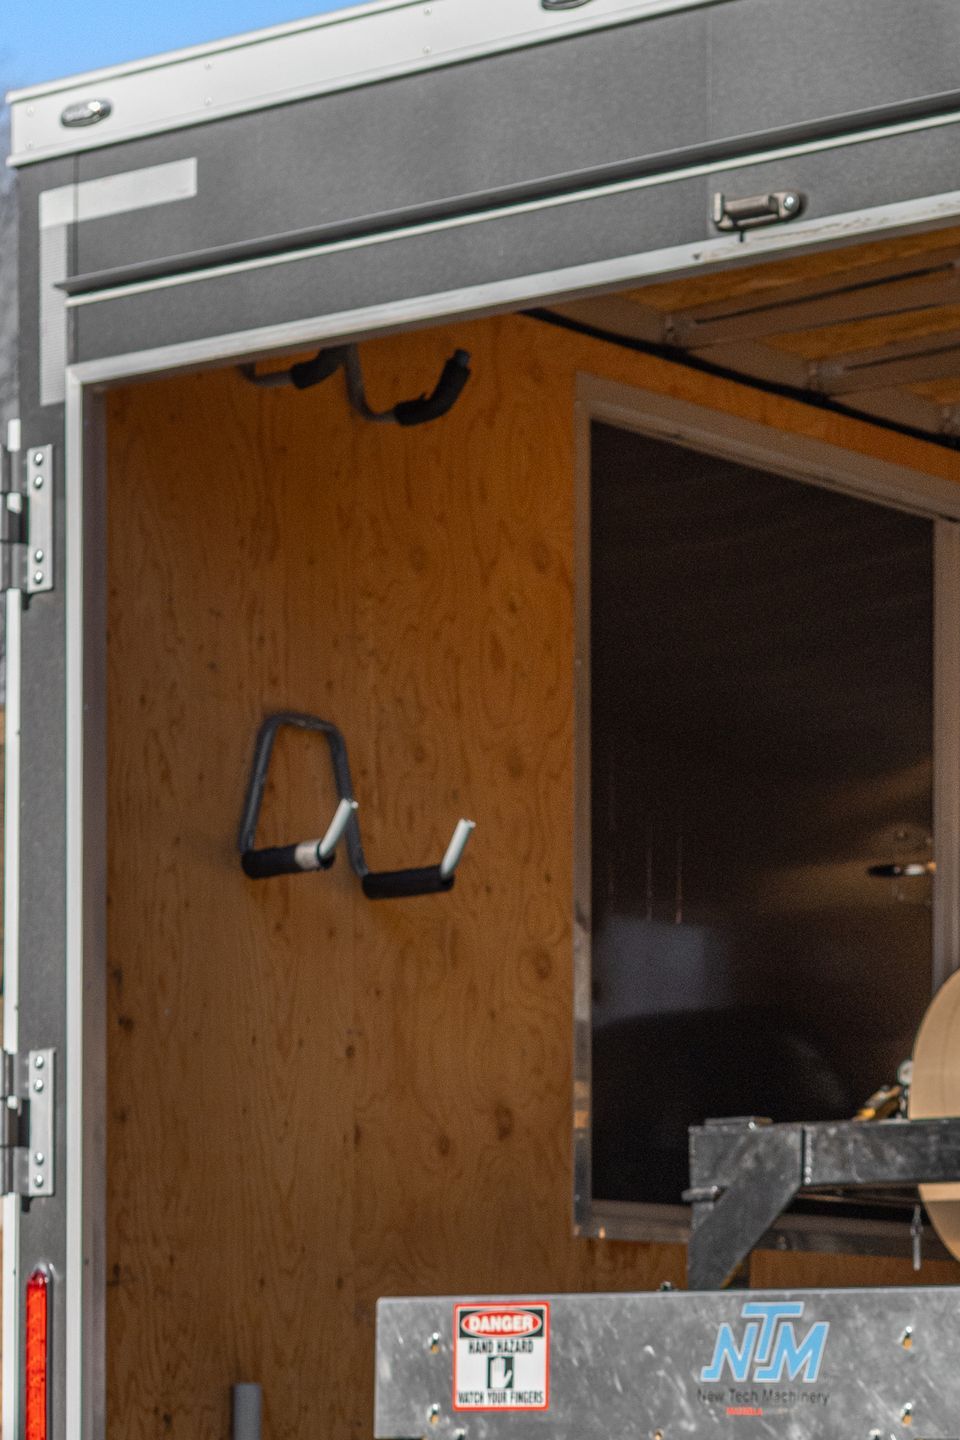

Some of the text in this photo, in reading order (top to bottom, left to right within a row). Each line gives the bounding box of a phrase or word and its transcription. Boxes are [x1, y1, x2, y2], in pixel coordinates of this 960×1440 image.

[468, 1314, 533, 1333] DANGER
[468, 1340, 534, 1353] HAND HAZARD
[700, 1301, 830, 1383] NTM
[458, 1391, 543, 1404] WATCH YOUR FINGERS
[697, 1387, 830, 1406] New Tech Machinery
